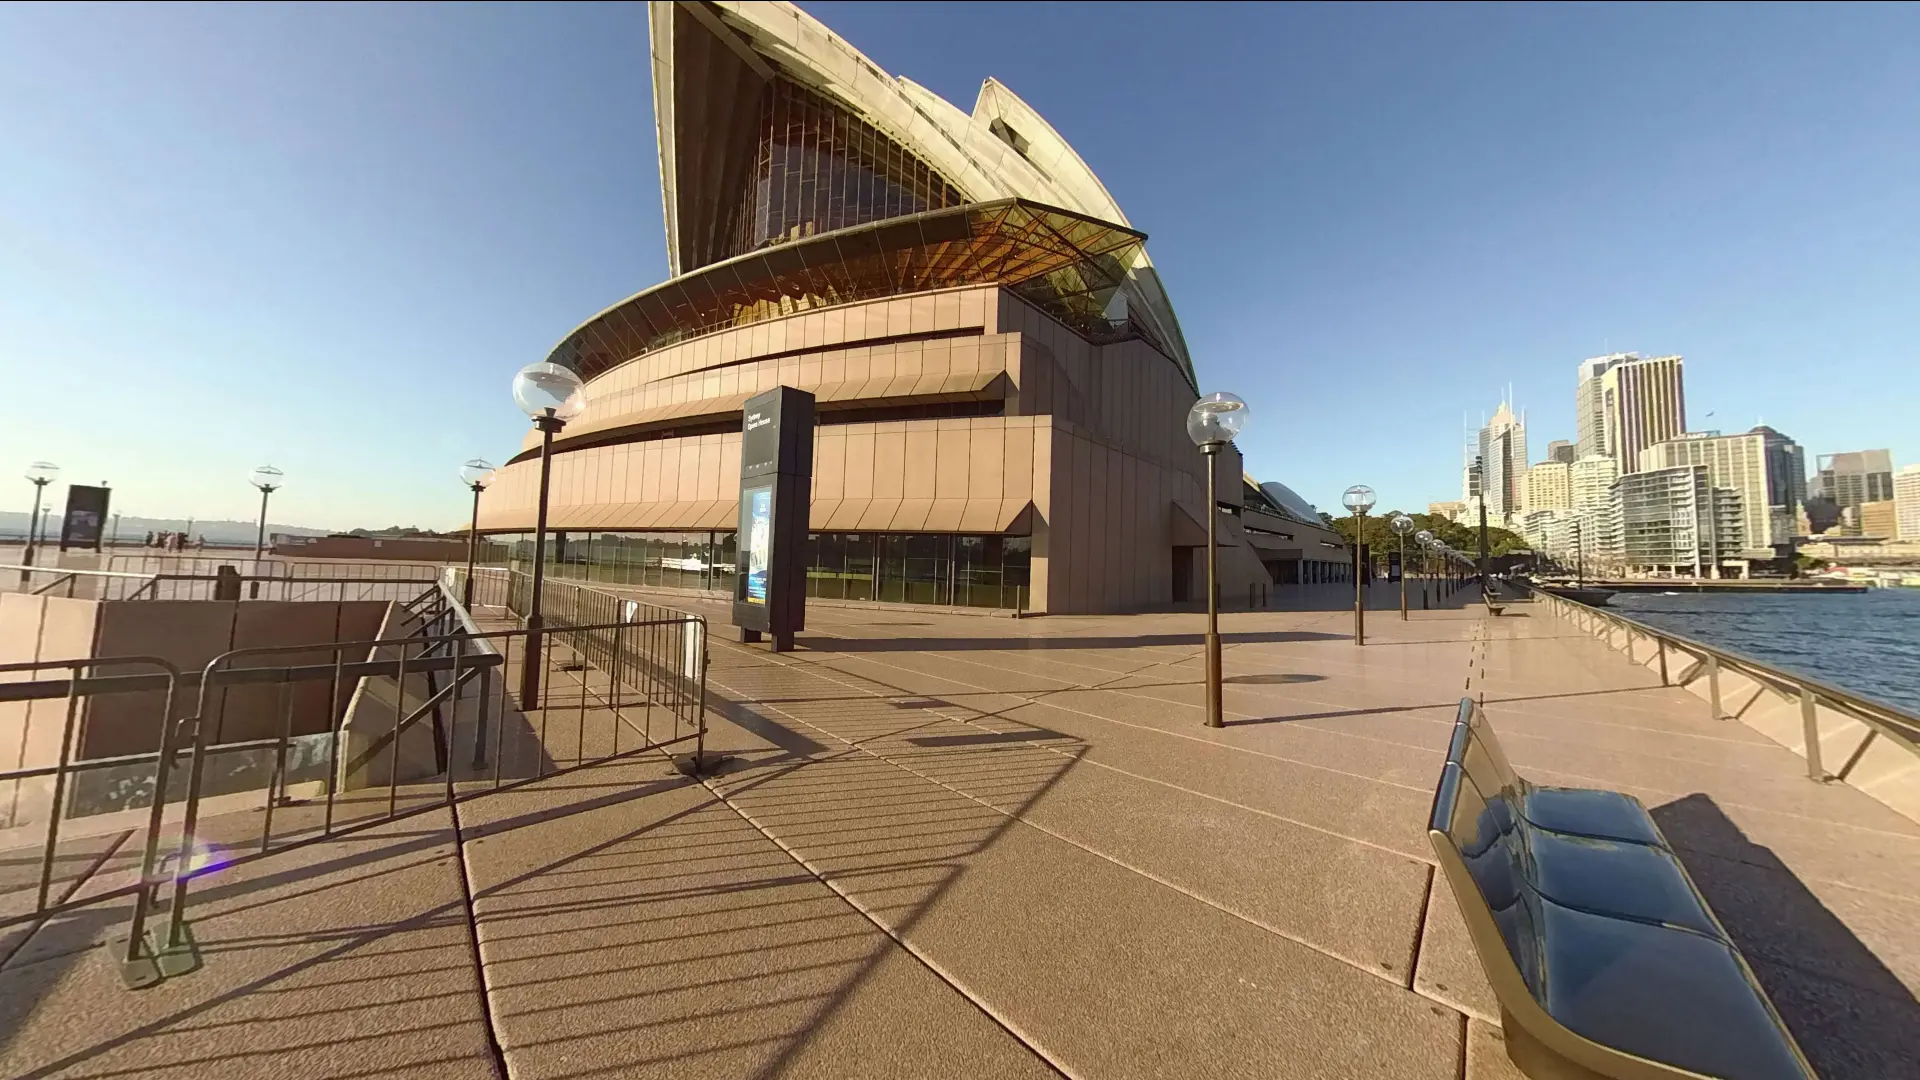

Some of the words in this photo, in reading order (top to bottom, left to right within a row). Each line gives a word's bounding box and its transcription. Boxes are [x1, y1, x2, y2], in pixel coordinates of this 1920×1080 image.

[748, 412, 761, 422] Sydney
[748, 422, 758, 431] Opera
[758, 417, 771, 427] House
